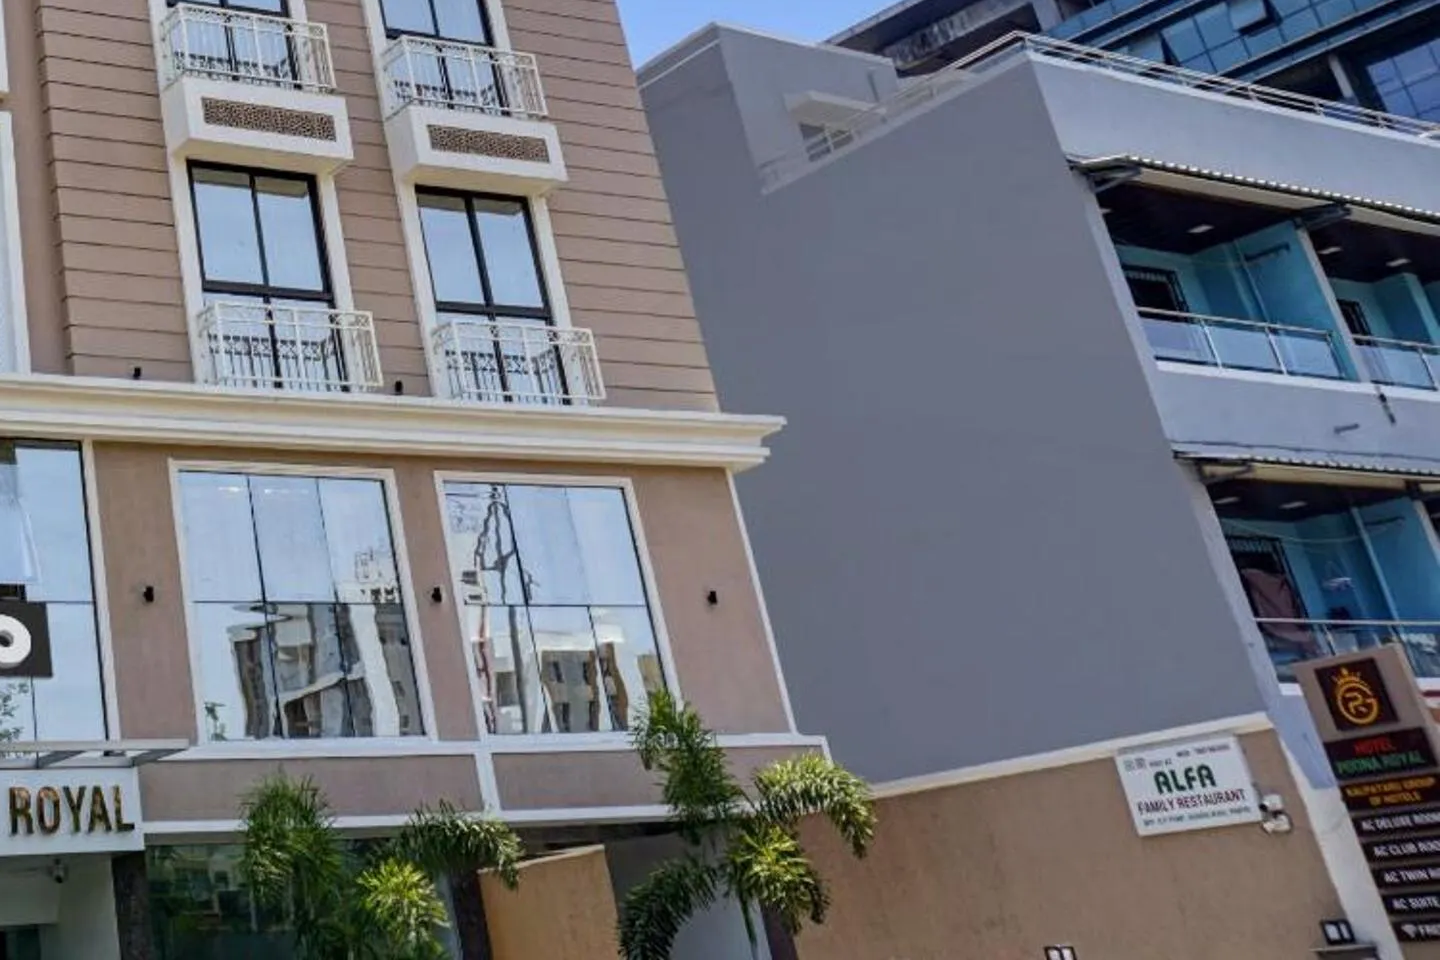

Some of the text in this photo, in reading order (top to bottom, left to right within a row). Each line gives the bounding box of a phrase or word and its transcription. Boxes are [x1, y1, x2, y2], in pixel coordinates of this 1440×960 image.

[1154, 763, 1217, 795] ALFA
[9, 784, 136, 836] ROYAL
[1137, 788, 1246, 816] FAMILY RESTAURANT
[1388, 842, 1418, 856] CLUB
